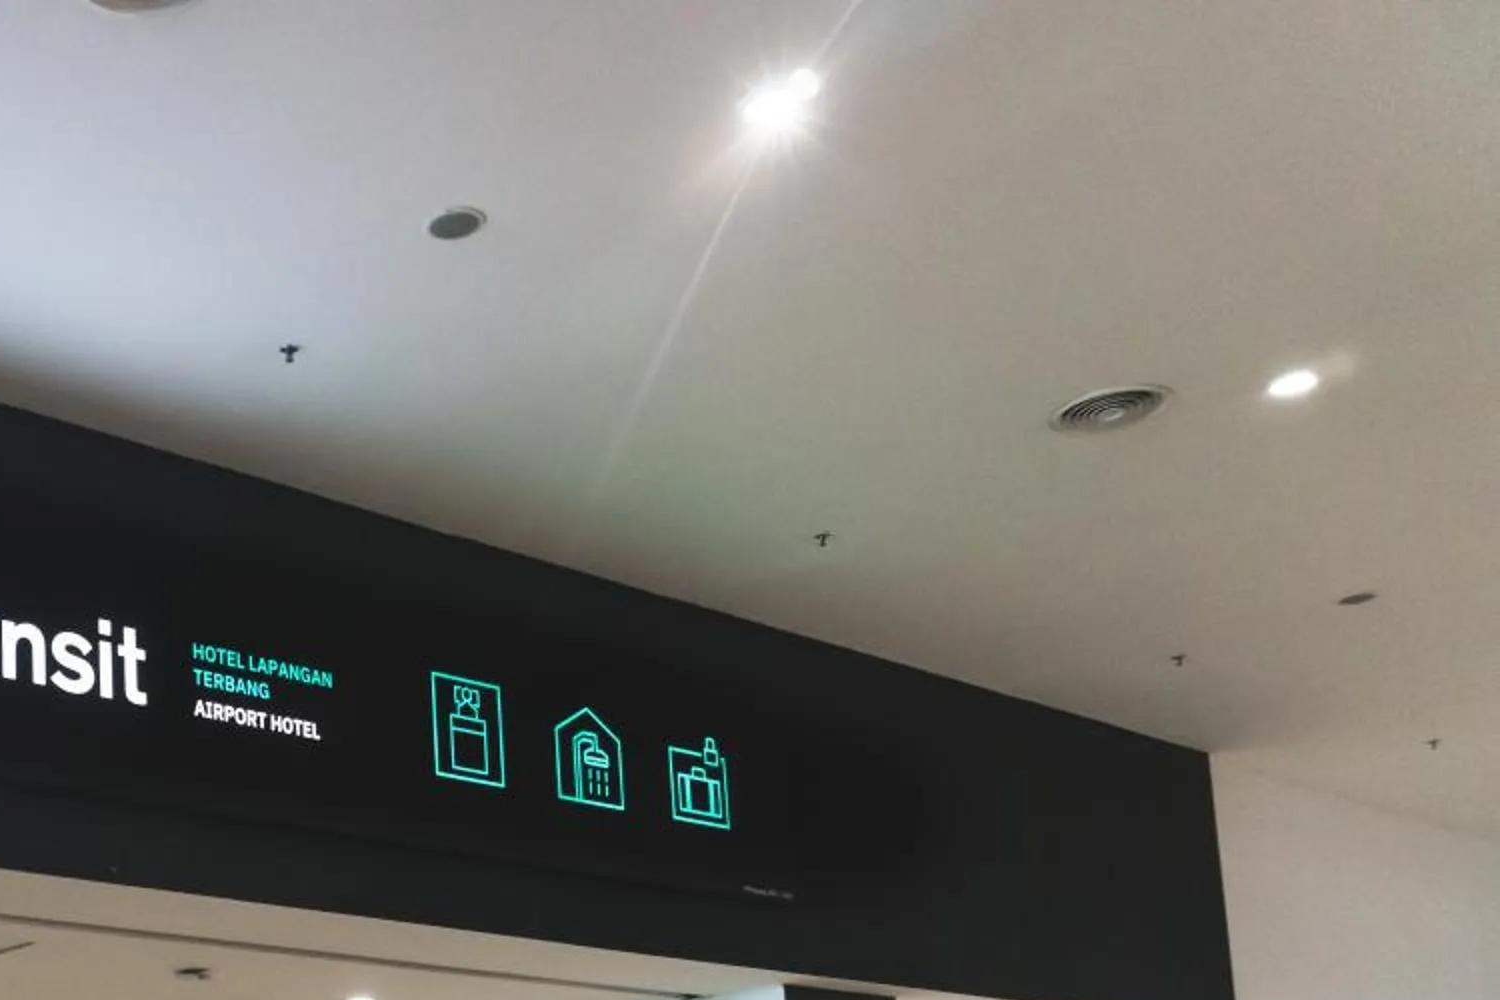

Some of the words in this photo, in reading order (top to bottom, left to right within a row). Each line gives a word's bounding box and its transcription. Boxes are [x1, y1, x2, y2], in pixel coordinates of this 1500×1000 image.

[192, 642, 245, 670] HOTEL
[249, 655, 333, 688] LAPANGAN
[193, 668, 271, 700] TERBANG
[194, 699, 267, 729] AIRPORT
[270, 713, 321, 741] HOTEL
